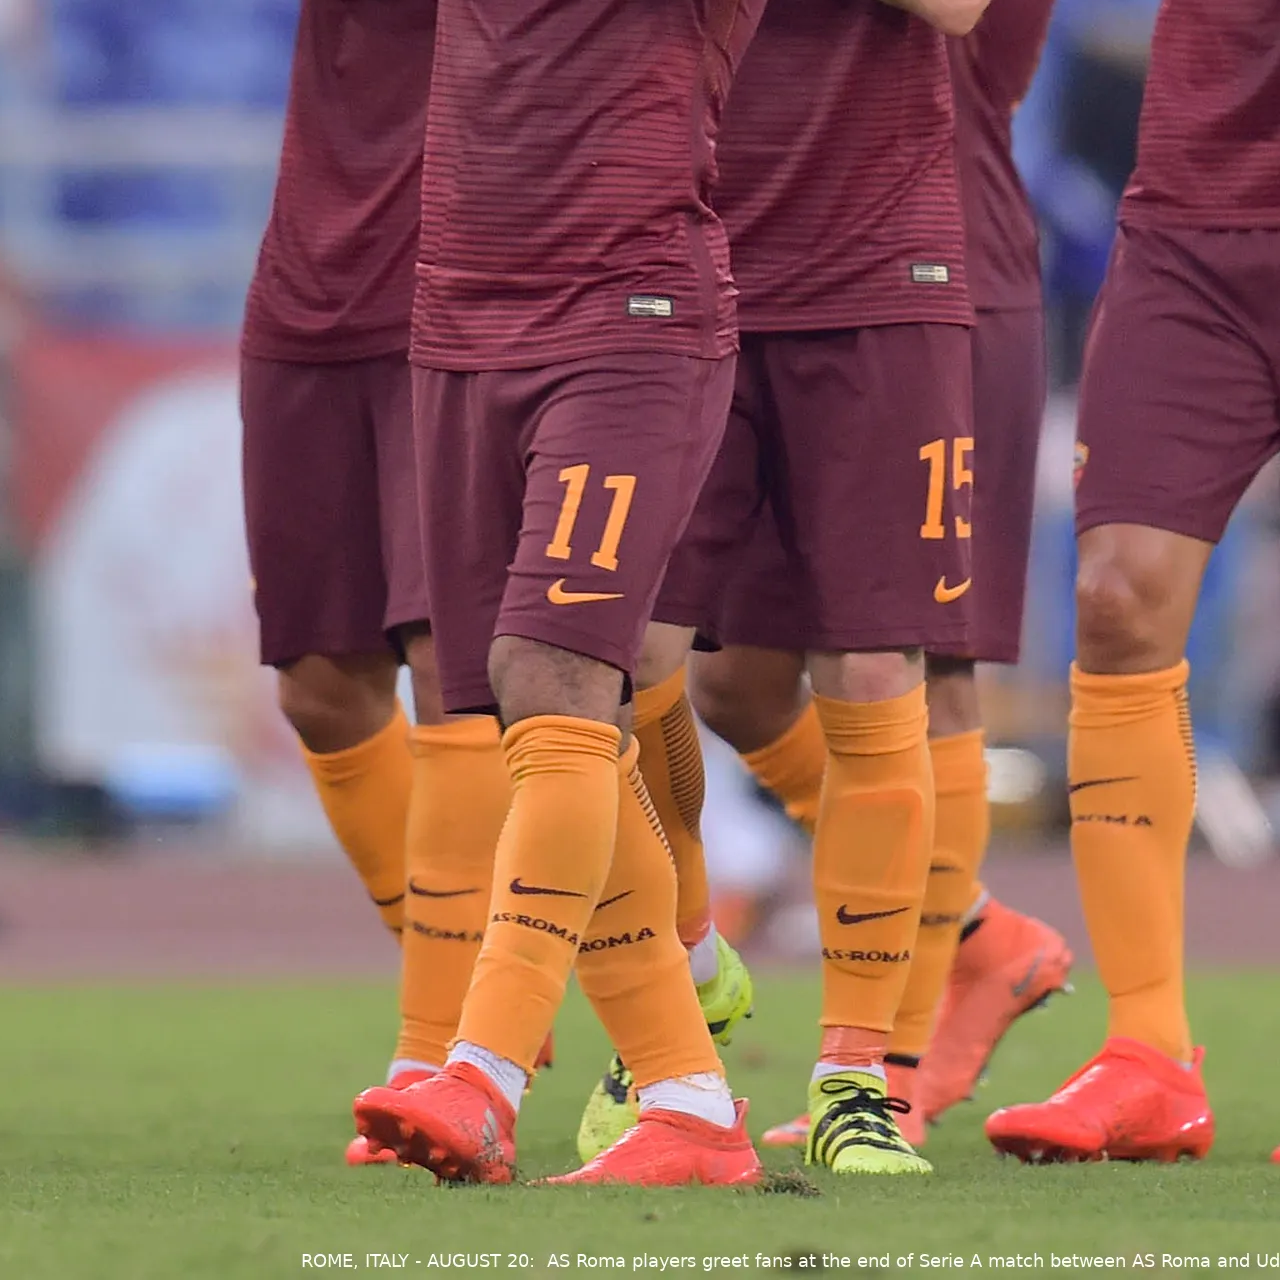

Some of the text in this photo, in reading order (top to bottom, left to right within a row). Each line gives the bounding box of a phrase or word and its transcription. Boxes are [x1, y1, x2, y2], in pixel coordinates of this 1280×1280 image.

[545, 463, 637, 572] 11
[919, 436, 975, 539] 15
[821, 946, 912, 963] AS-ROMA
